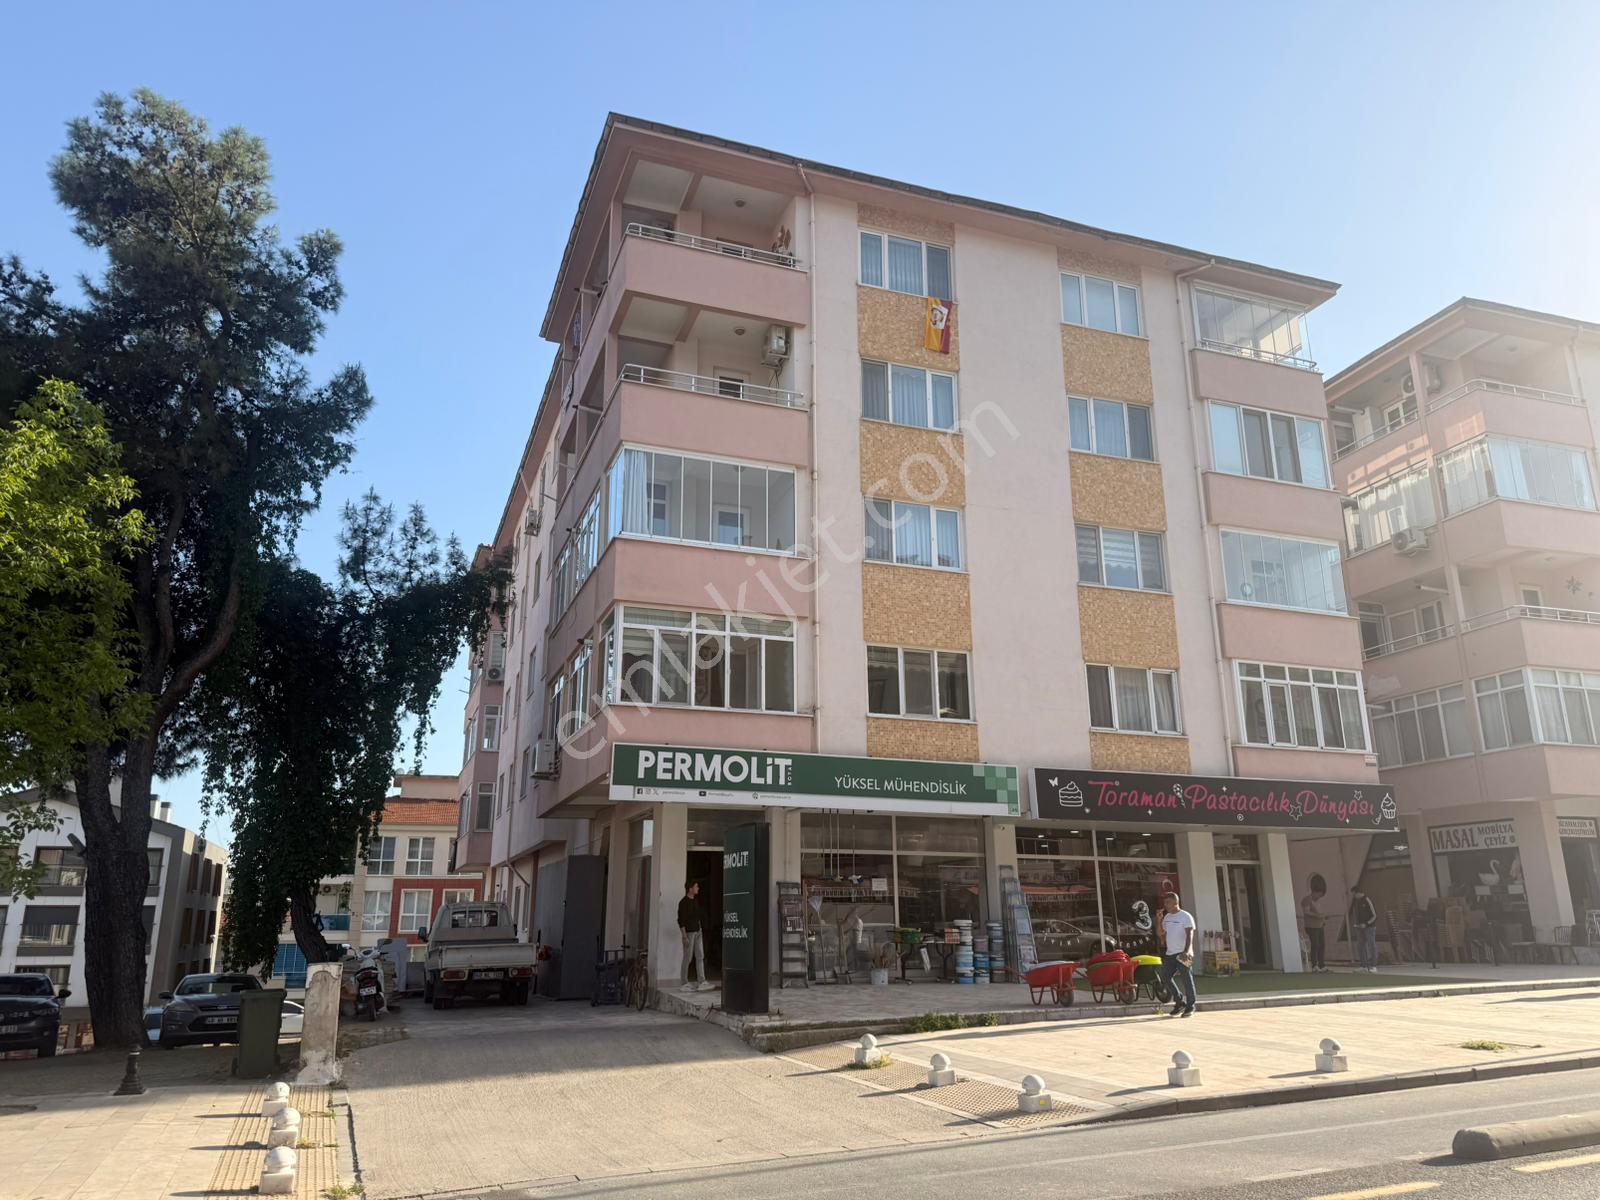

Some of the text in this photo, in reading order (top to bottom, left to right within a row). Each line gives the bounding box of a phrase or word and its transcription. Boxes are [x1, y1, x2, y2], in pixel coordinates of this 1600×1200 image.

[834, 774, 967, 796] YÜKSEL MÜHENDİSLİK
[1087, 779, 1375, 821] Toraman Pastacılık Dünyası
[1432, 823, 1514, 850] MASAL MOBİLYA
[1484, 834, 1509, 849] ÇEYİZ
